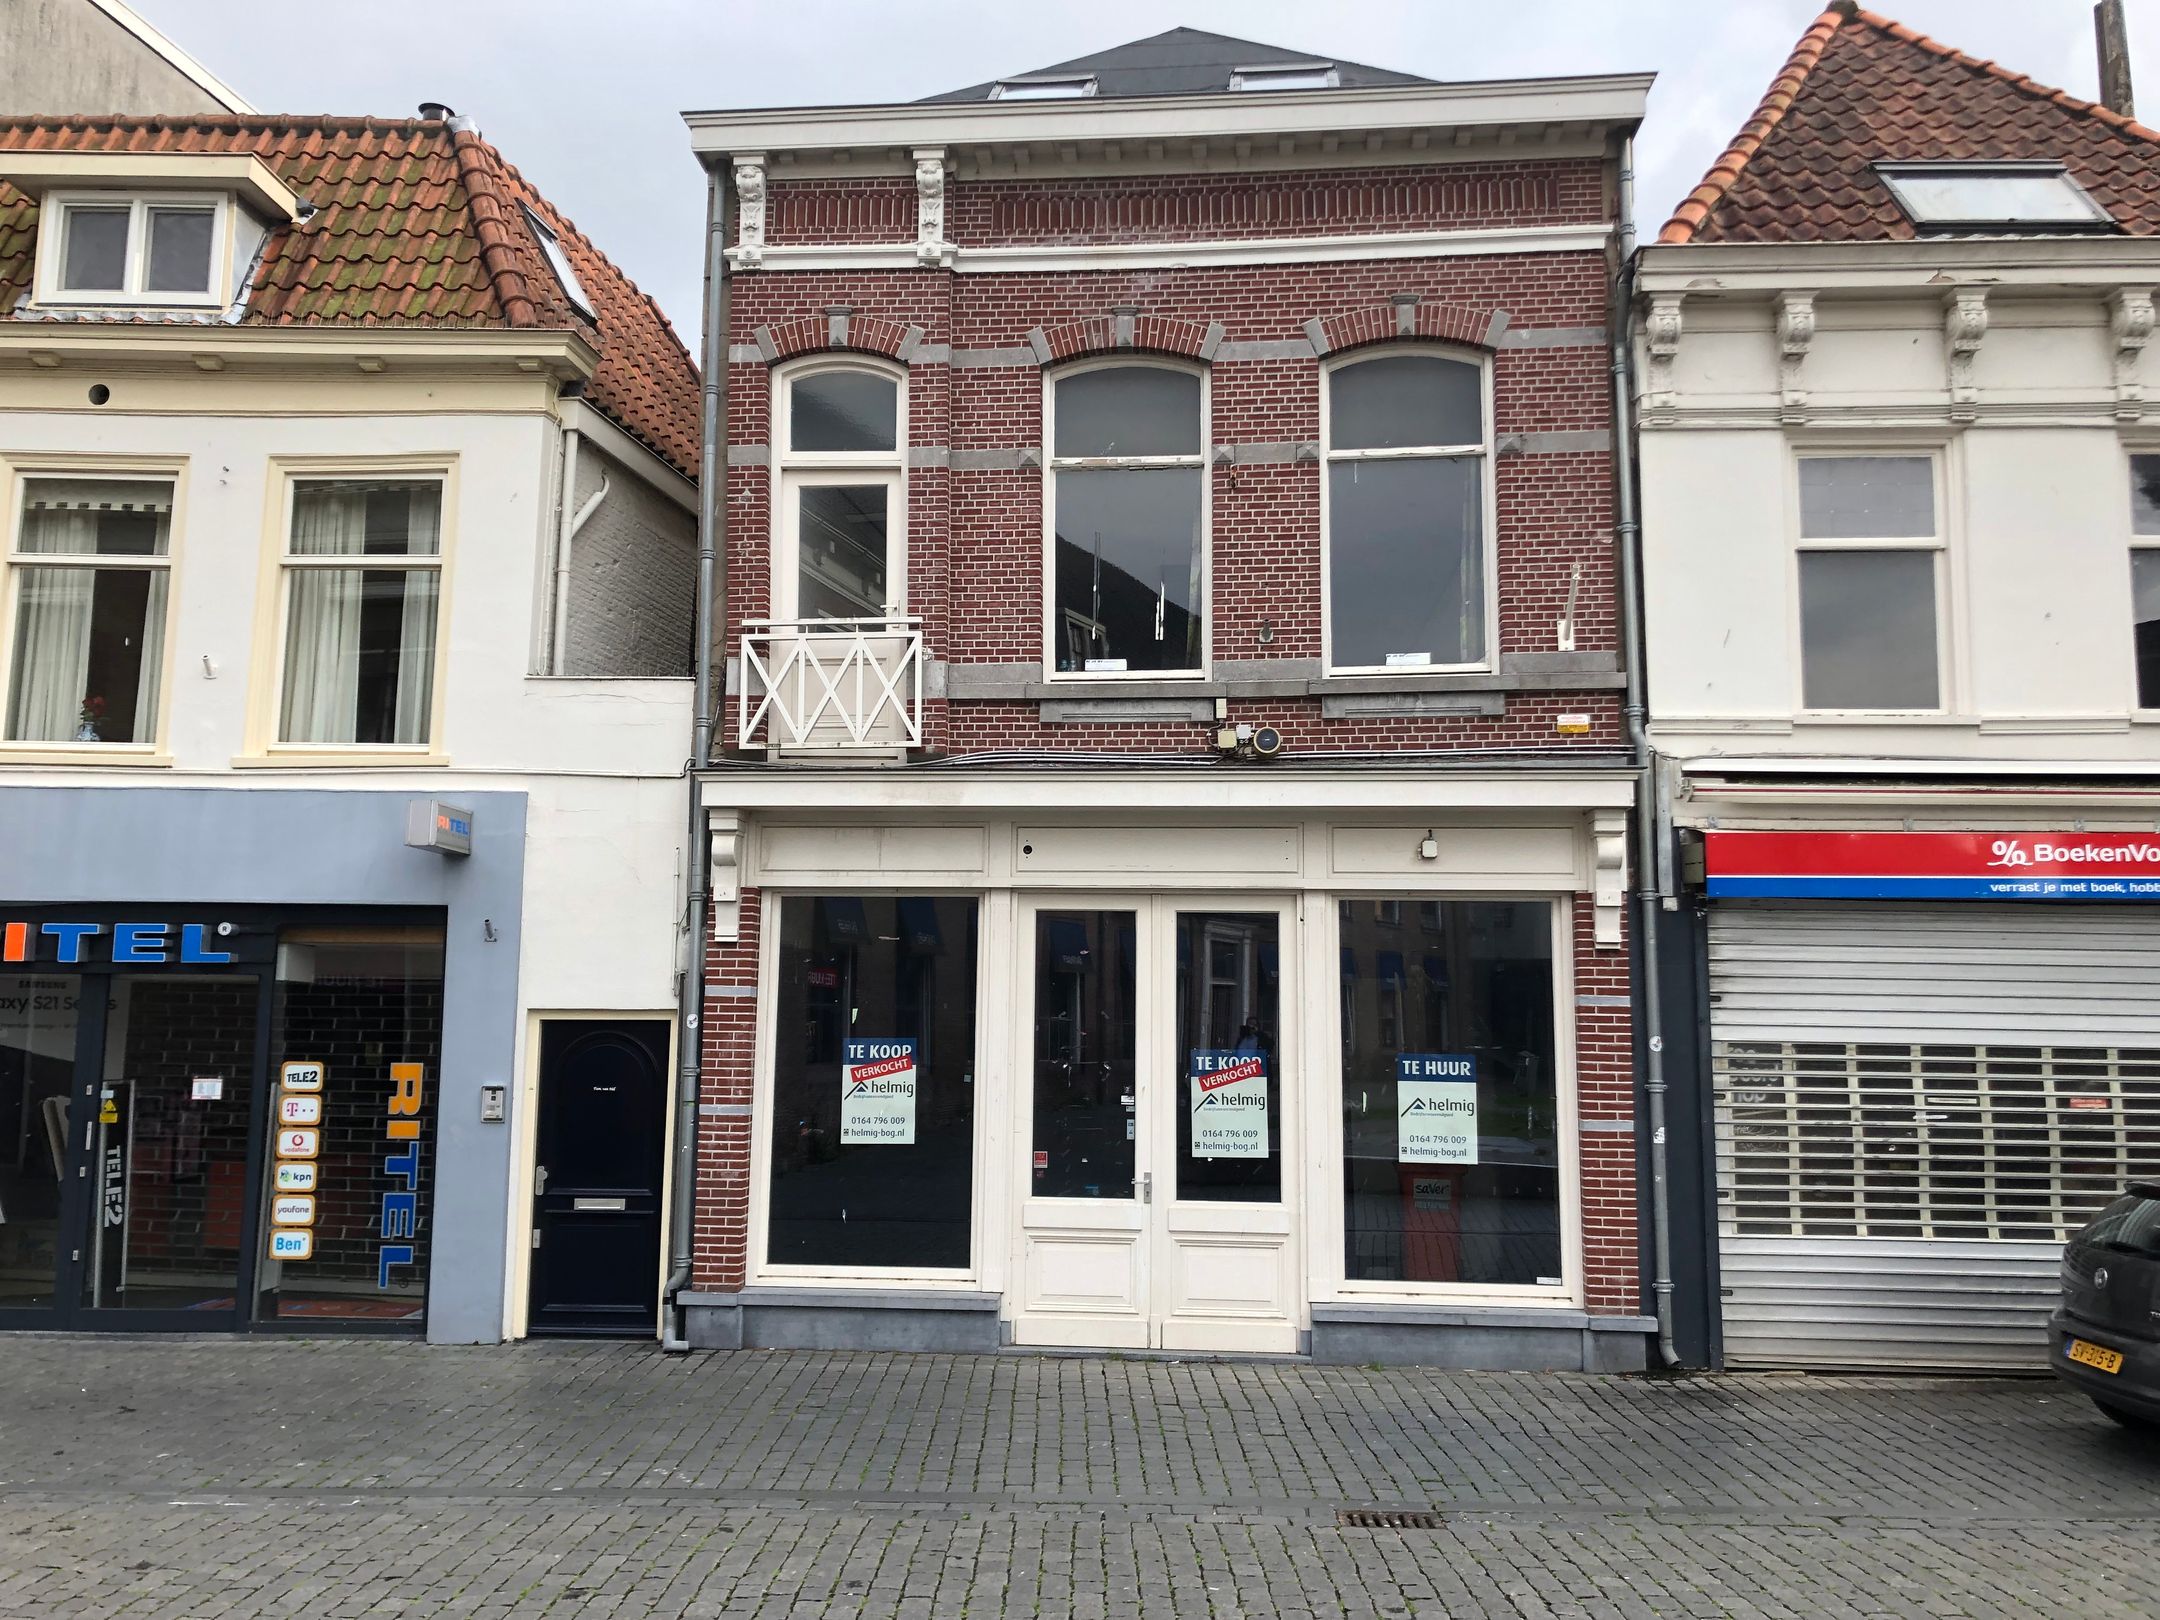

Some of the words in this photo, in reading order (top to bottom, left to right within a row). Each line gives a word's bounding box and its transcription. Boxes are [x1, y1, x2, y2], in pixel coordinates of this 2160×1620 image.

[1990, 883, 2040, 892] verrast
[2043, 882, 2056, 894] je
[2061, 882, 2086, 892] met
[2091, 882, 2126, 893] boek,
[848, 1044, 865, 1059] TE
[869, 1044, 912, 1059] KOOP
[853, 1058, 909, 1079] VERKOCHT
[1196, 1056, 1213, 1071] TE
[1402, 1060, 1420, 1075] TE
[1425, 1061, 1471, 1076] HUUR
[286, 1070, 318, 1083] TELE2
[1202, 1063, 1258, 1088] VERKOCHT
[871, 1080, 914, 1098] helmig
[1221, 1092, 1266, 1111] helmig
[1429, 1098, 1475, 1117] helmig
[851, 1116, 872, 1125] 0164
[874, 1116, 889, 1125] 796
[890, 1116, 906, 1125] 009
[851, 1128, 905, 1138] helmig-bog.nl
[1202, 1129, 1223, 1138] 0164
[1225, 1129, 1241, 1138] 796
[1242, 1129, 1259, 1138] 009
[1409, 1134, 1431, 1143] 0164
[1433, 1135, 1449, 1144] 796
[1450, 1136, 1467, 1144] 009
[1202, 1141, 1259, 1153] helmig-bog.nl
[1409, 1146, 1467, 1158] helmig-bog.nl
[293, 1172, 312, 1182] kpn
[378, 1062, 424, 1289] RITEL
[104, 1144, 123, 1228] TELE2
[277, 1205, 310, 1215] youfone
[275, 1237, 302, 1250] Ben
